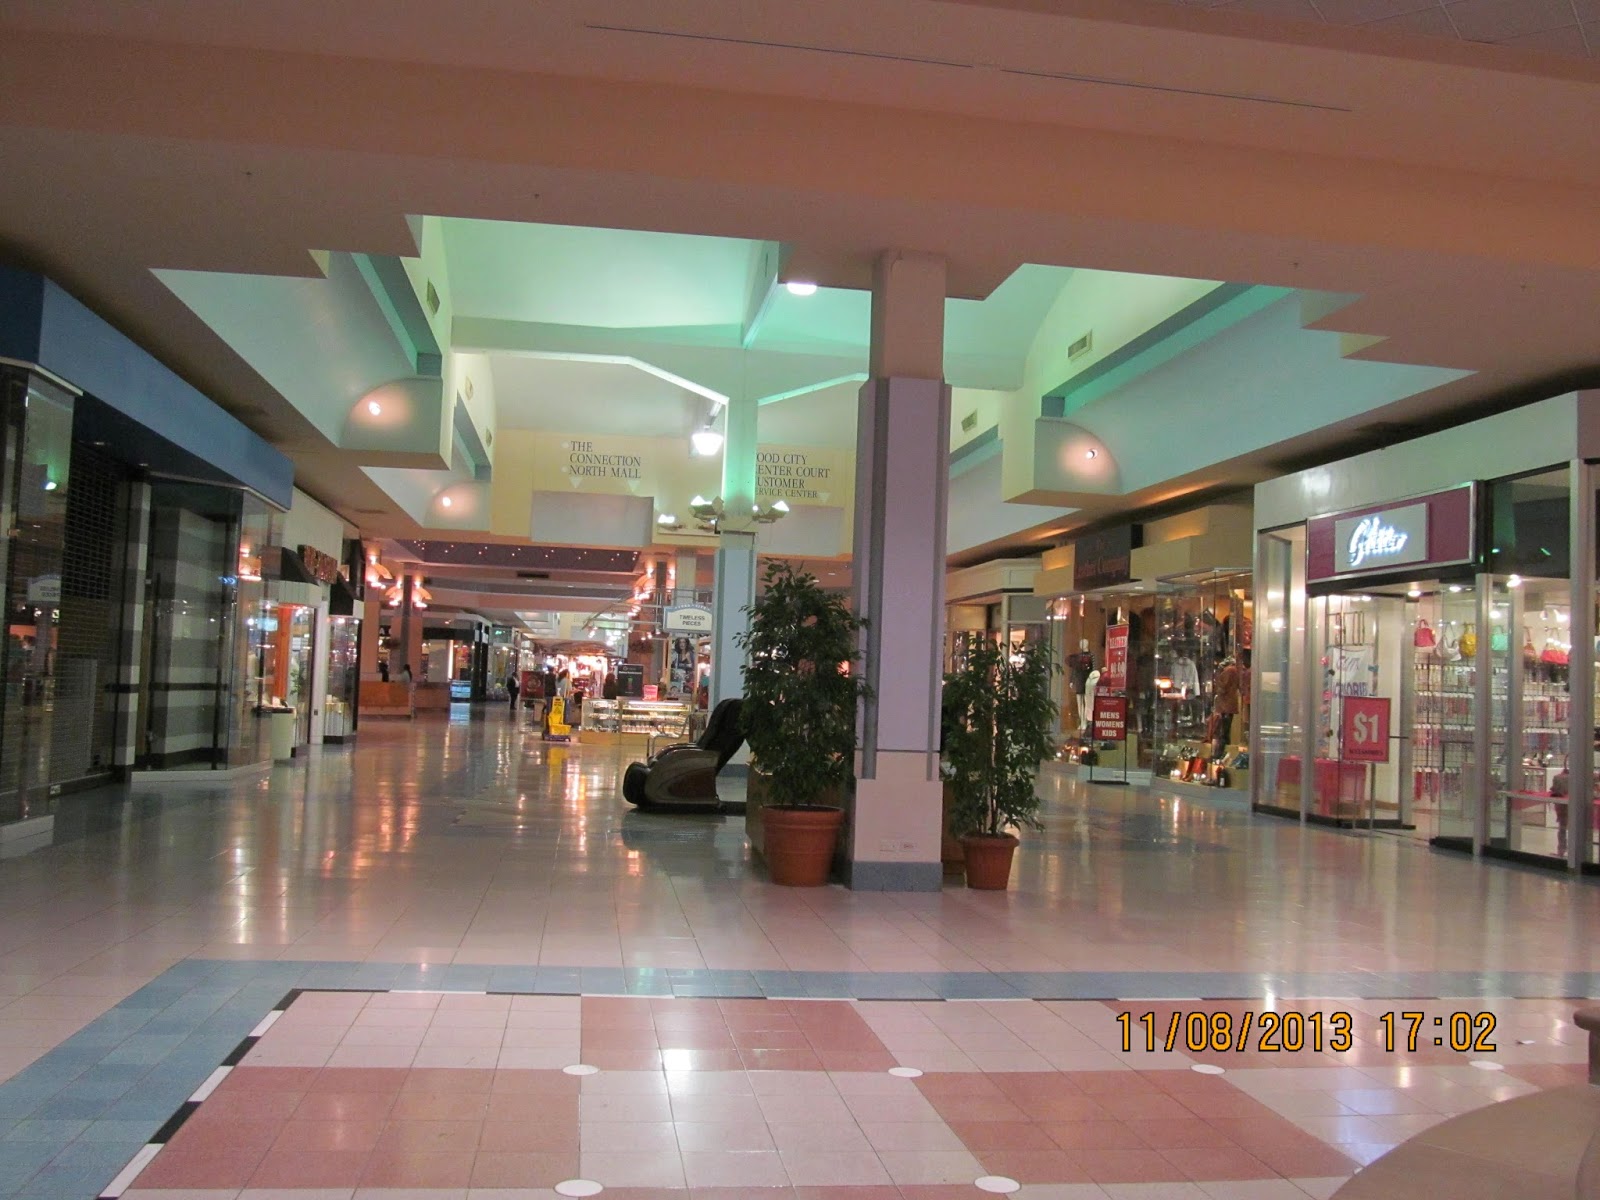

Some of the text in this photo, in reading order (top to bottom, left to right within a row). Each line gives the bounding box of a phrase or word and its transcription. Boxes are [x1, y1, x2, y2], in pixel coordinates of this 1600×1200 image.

[571, 441, 593, 452] THE
[569, 453, 641, 466] CONNECTION
[756, 453, 808, 465] OOD CITY
[569, 465, 641, 478] NORTH MALL
[756, 464, 830, 478] ENTER COURT
[757, 476, 805, 488] USTOMER
[756, 488, 818, 498] ERVICE CENTER
[1100, 711, 1120, 719] MENS
[1101, 729, 1117, 737] KIDS
[1353, 711, 1379, 744] $1
